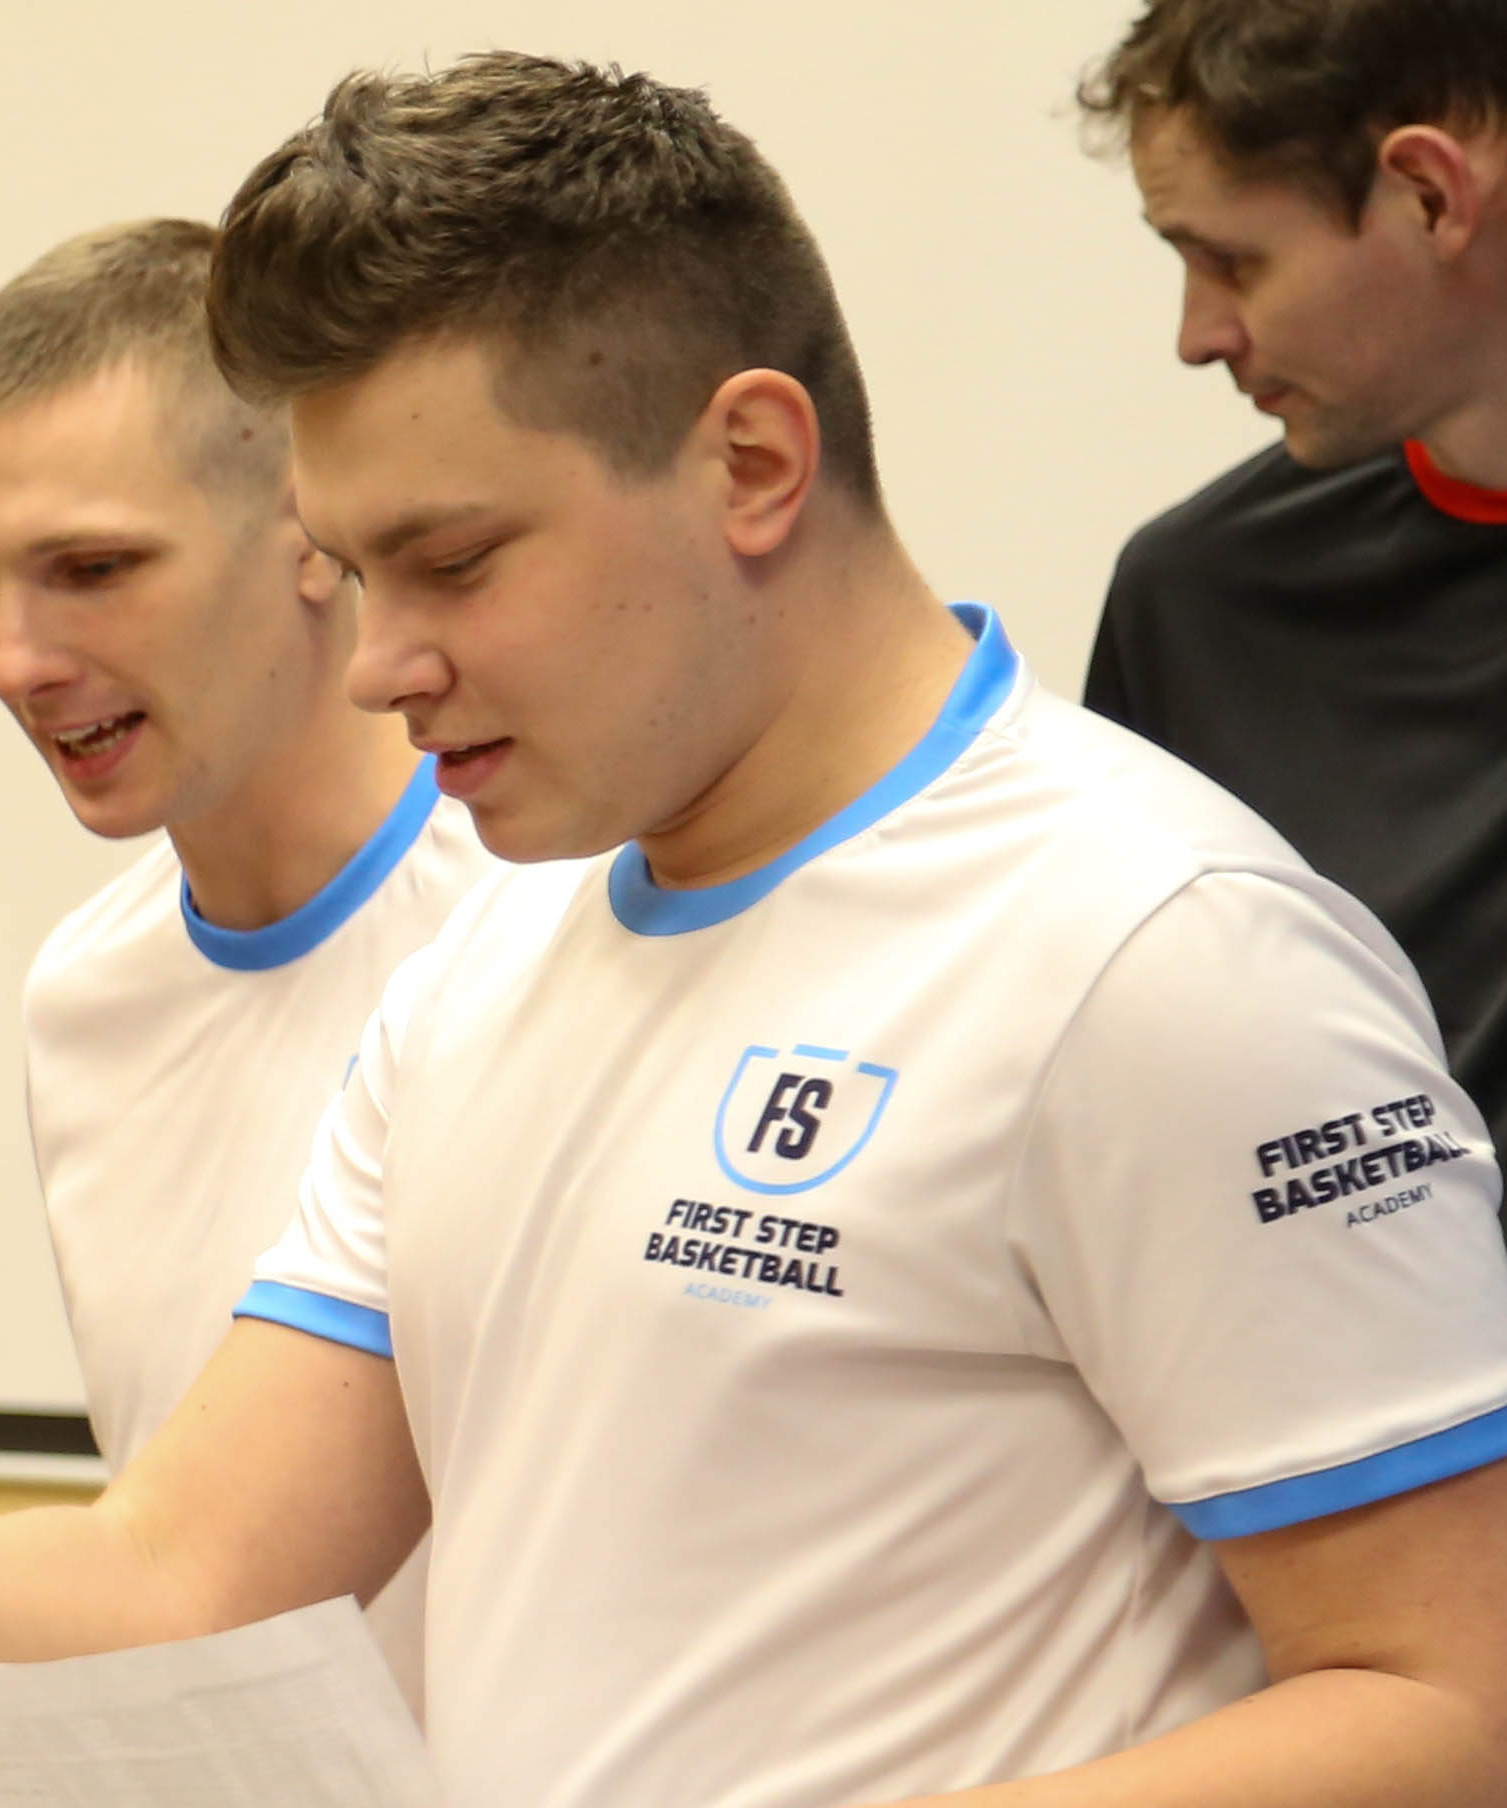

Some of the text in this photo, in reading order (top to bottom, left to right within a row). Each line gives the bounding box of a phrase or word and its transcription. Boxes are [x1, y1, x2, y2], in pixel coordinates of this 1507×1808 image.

[746, 1072, 834, 1161] FS
[1255, 1093, 1435, 1177] FIRST STEP
[1251, 1130, 1473, 1224] BASKETBALL
[1345, 1181, 1435, 1229] ACADEMY
[664, 1198, 840, 1255] FIRST STEP
[643, 1232, 844, 1298] BASKETBALL
[682, 1282, 774, 1311] ACADEMY
